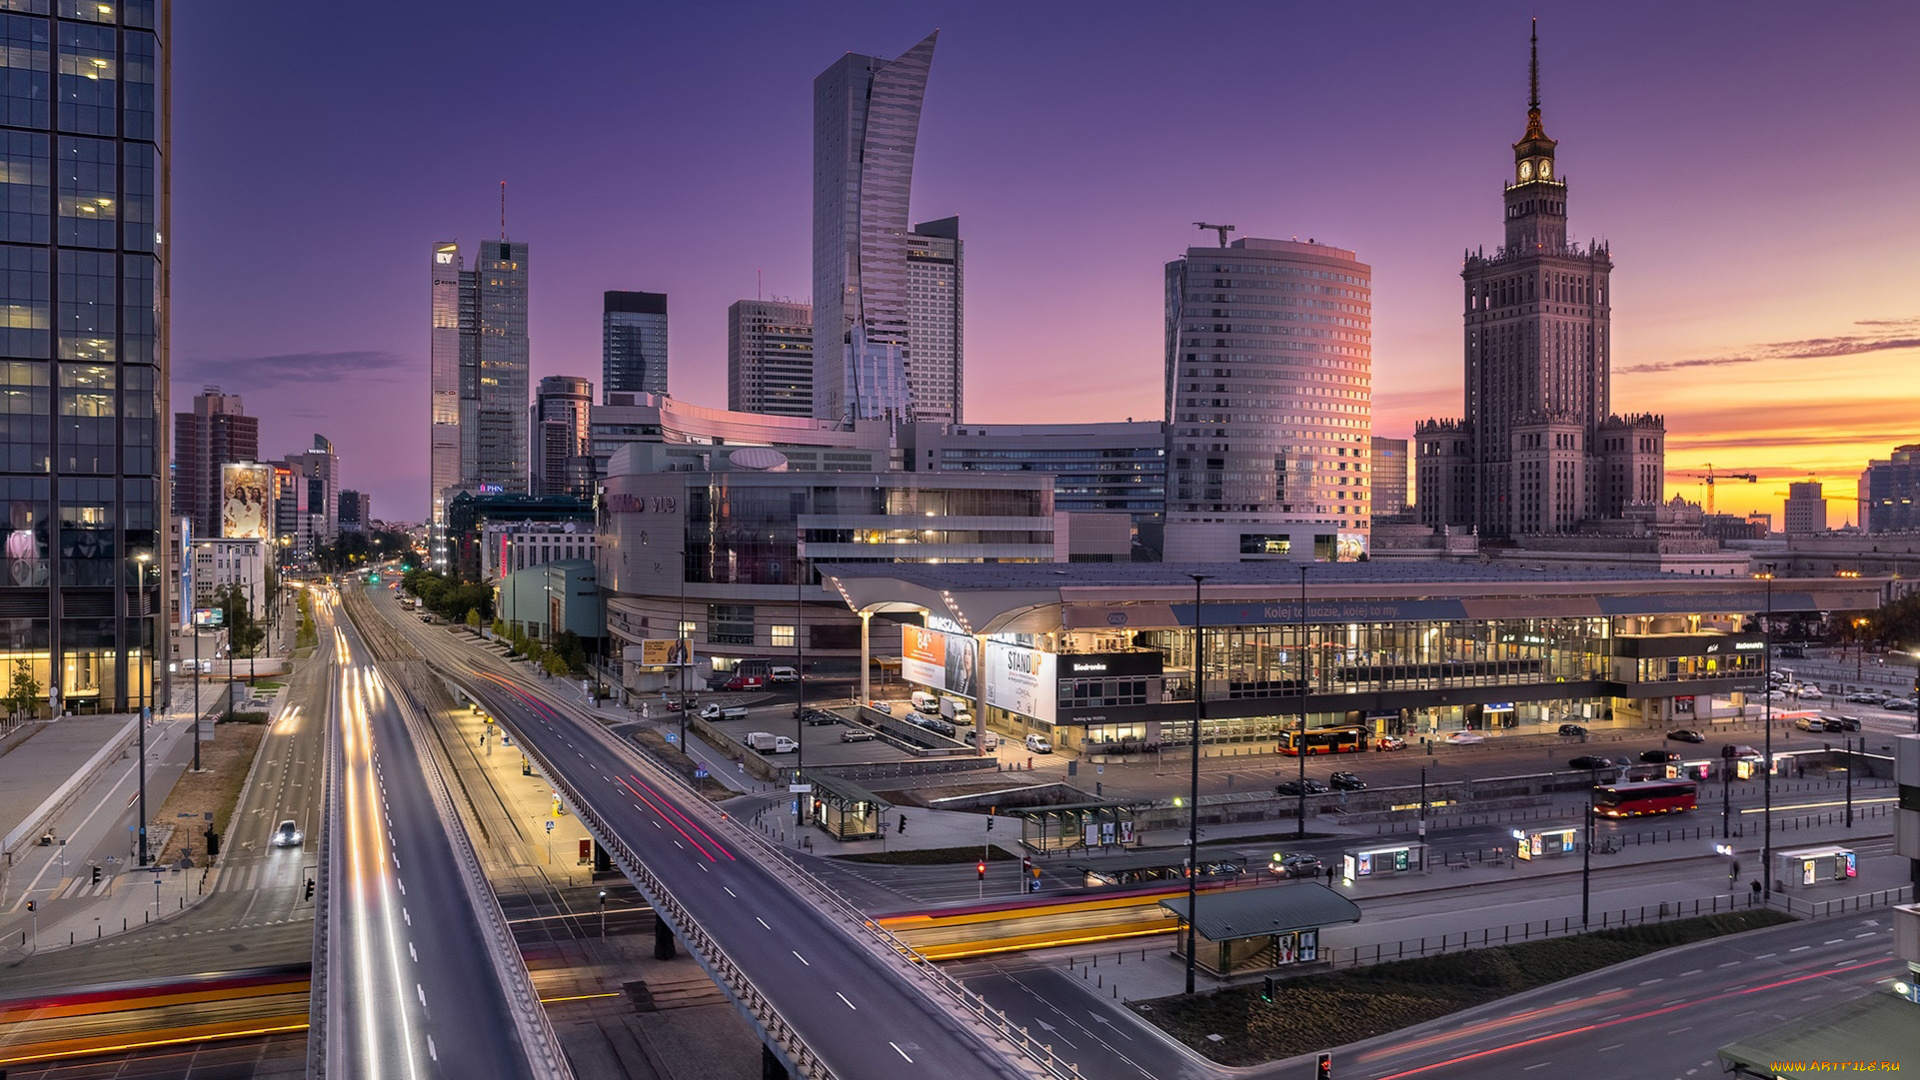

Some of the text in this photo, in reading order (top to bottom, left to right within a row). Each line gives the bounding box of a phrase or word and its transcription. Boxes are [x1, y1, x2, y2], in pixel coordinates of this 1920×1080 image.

[436, 252, 455, 265] EY
[486, 485, 503, 493] PHN
[1264, 605, 1291, 620] Kolej
[1307, 605, 1341, 618] ludzie,
[1343, 604, 1369, 618] kolej
[1370, 605, 1381, 616] to
[1382, 606, 1400, 618] my.
[708, 635, 755, 646] RESERVED
[1073, 662, 1108, 672] Biedronka
